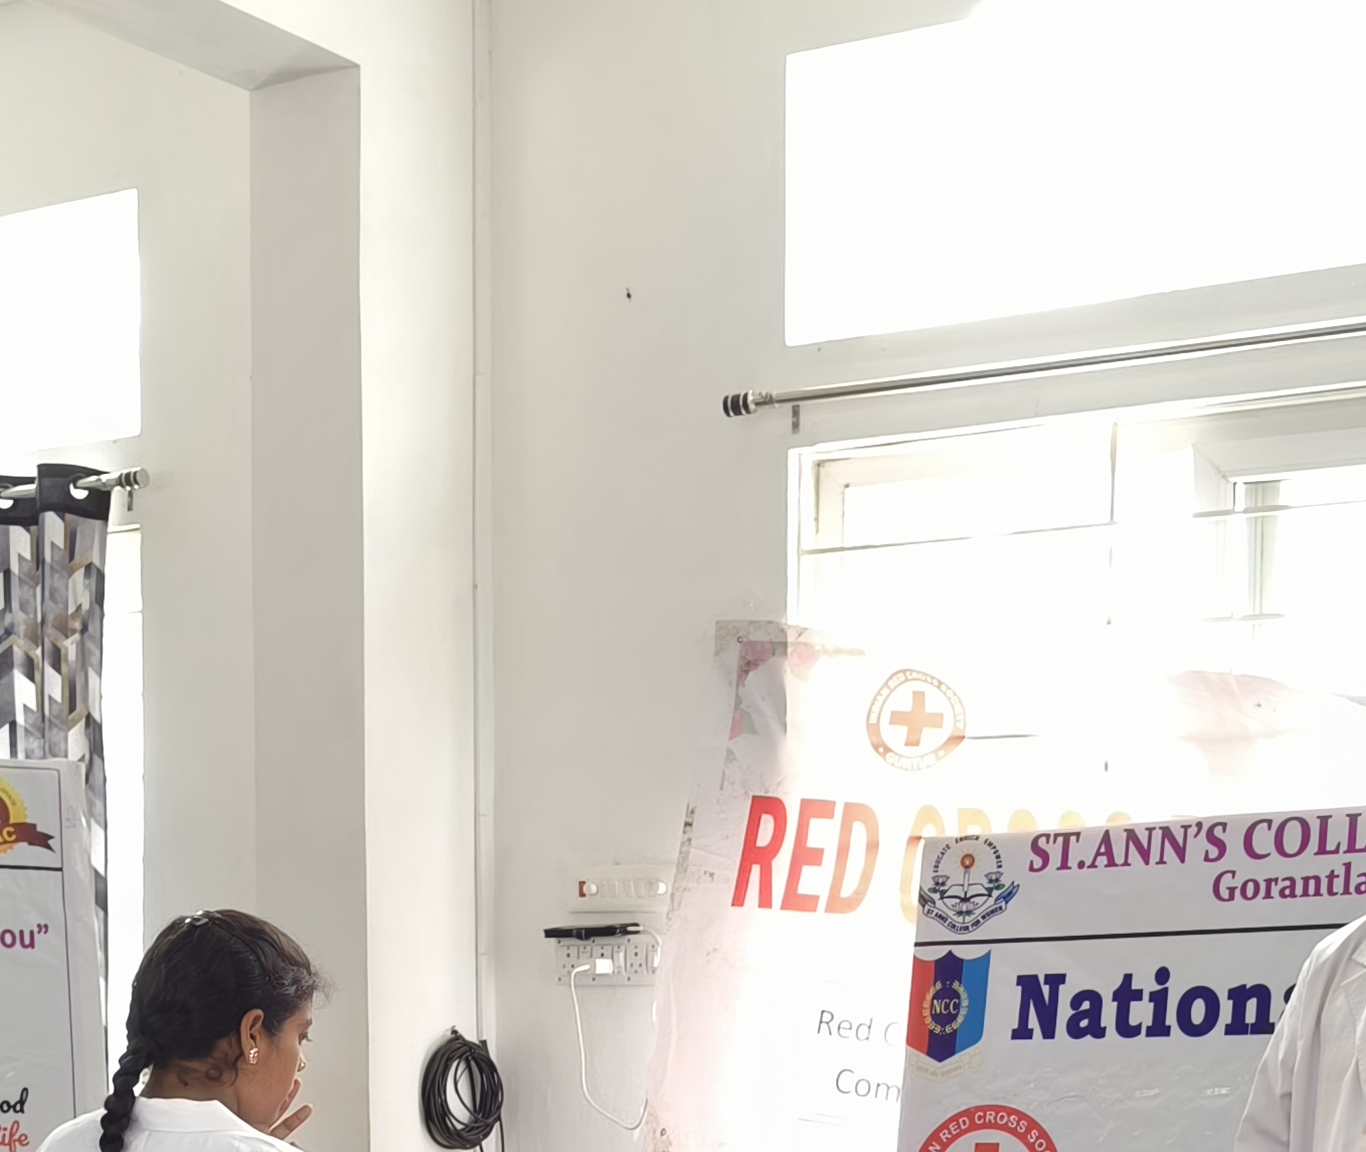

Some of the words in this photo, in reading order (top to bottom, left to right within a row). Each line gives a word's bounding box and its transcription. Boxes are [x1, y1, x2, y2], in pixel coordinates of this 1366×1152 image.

[731, 794, 879, 914] RED
[932, 999, 959, 1014] NCC
[1011, 966, 1296, 1040] Nation
[817, 1009, 874, 1041] Red
[835, 1068, 901, 1103] Com
[939, 1117, 969, 1142] RED
[975, 1111, 1027, 1133] CROSS
